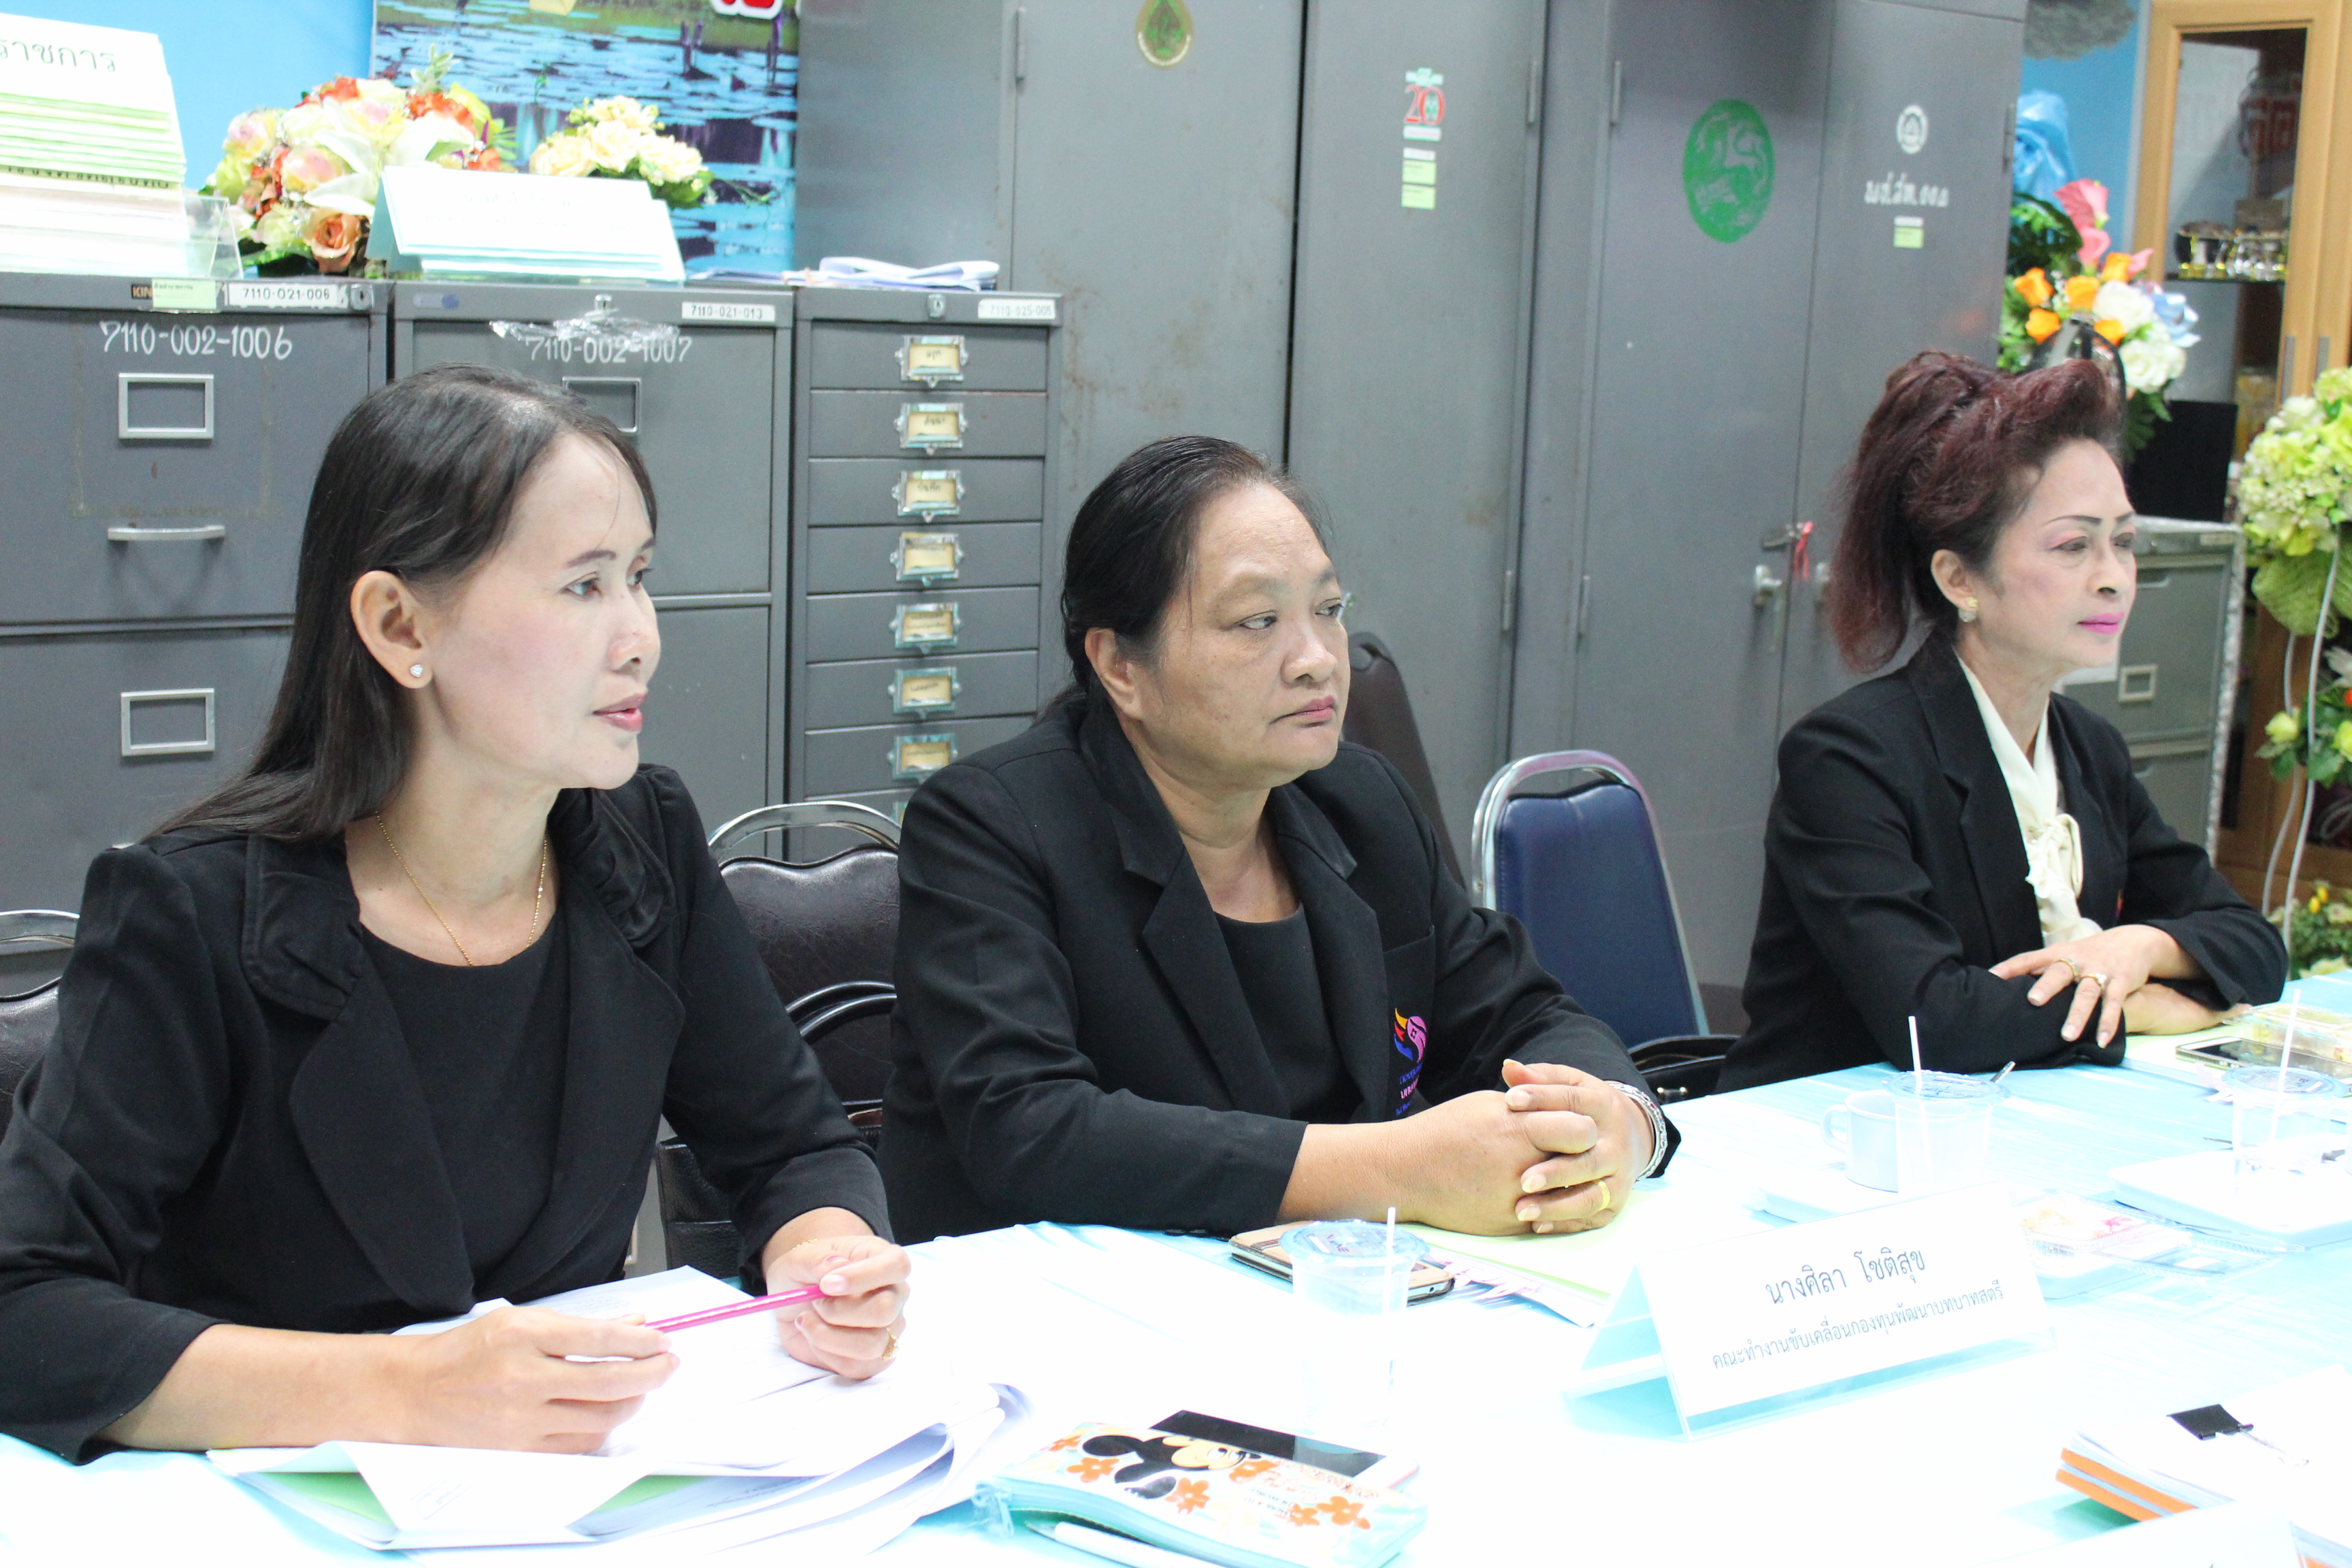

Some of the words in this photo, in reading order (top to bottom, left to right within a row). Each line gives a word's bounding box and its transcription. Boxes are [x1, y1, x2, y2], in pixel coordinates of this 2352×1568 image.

[1404, 84, 1446, 125] 20
[243, 287, 330, 301] 7110-021-006
[691, 304, 762, 319] 7110-021-013
[99, 321, 293, 360] 7110-002-1006
[1765, 1264, 1848, 1305] นางศิลา
[1853, 1246, 1926, 1284] โชติสุข
[1712, 1279, 2005, 1369] คณะทำงานขับเคลื่อนกองทุนพัฒนาบทบาทสตรี
